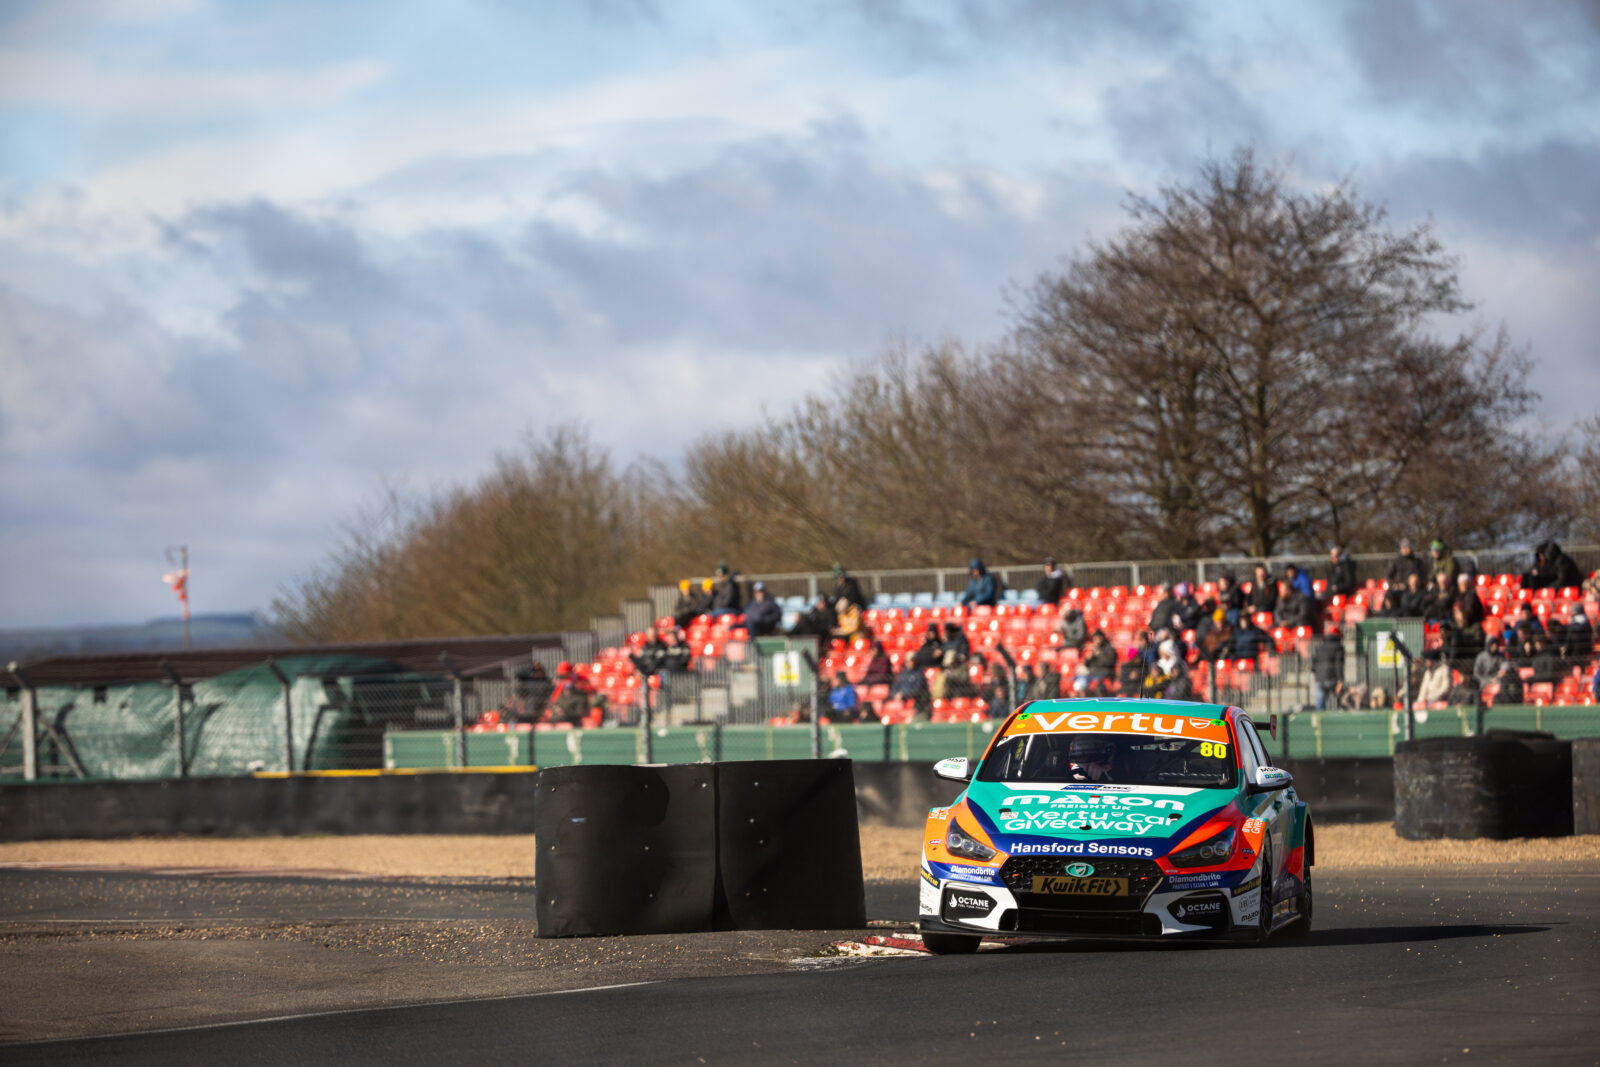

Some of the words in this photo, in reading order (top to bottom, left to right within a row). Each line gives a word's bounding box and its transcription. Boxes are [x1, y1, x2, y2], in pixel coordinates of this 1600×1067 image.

[1033, 712, 1184, 734] Vertu
[1200, 742, 1227, 759] 80
[1023, 810, 1108, 820] Vertu
[1126, 813, 1178, 826] Car
[1004, 819, 1153, 835] Giveaway
[1010, 842, 1084, 853] Hansford
[1087, 843, 1153, 857] Sensors
[950, 865, 995, 876] Diamondbrite
[1169, 873, 1221, 883] Diamondbrite
[958, 896, 989, 908] OCTANE
[1187, 902, 1221, 912] OCTANE
